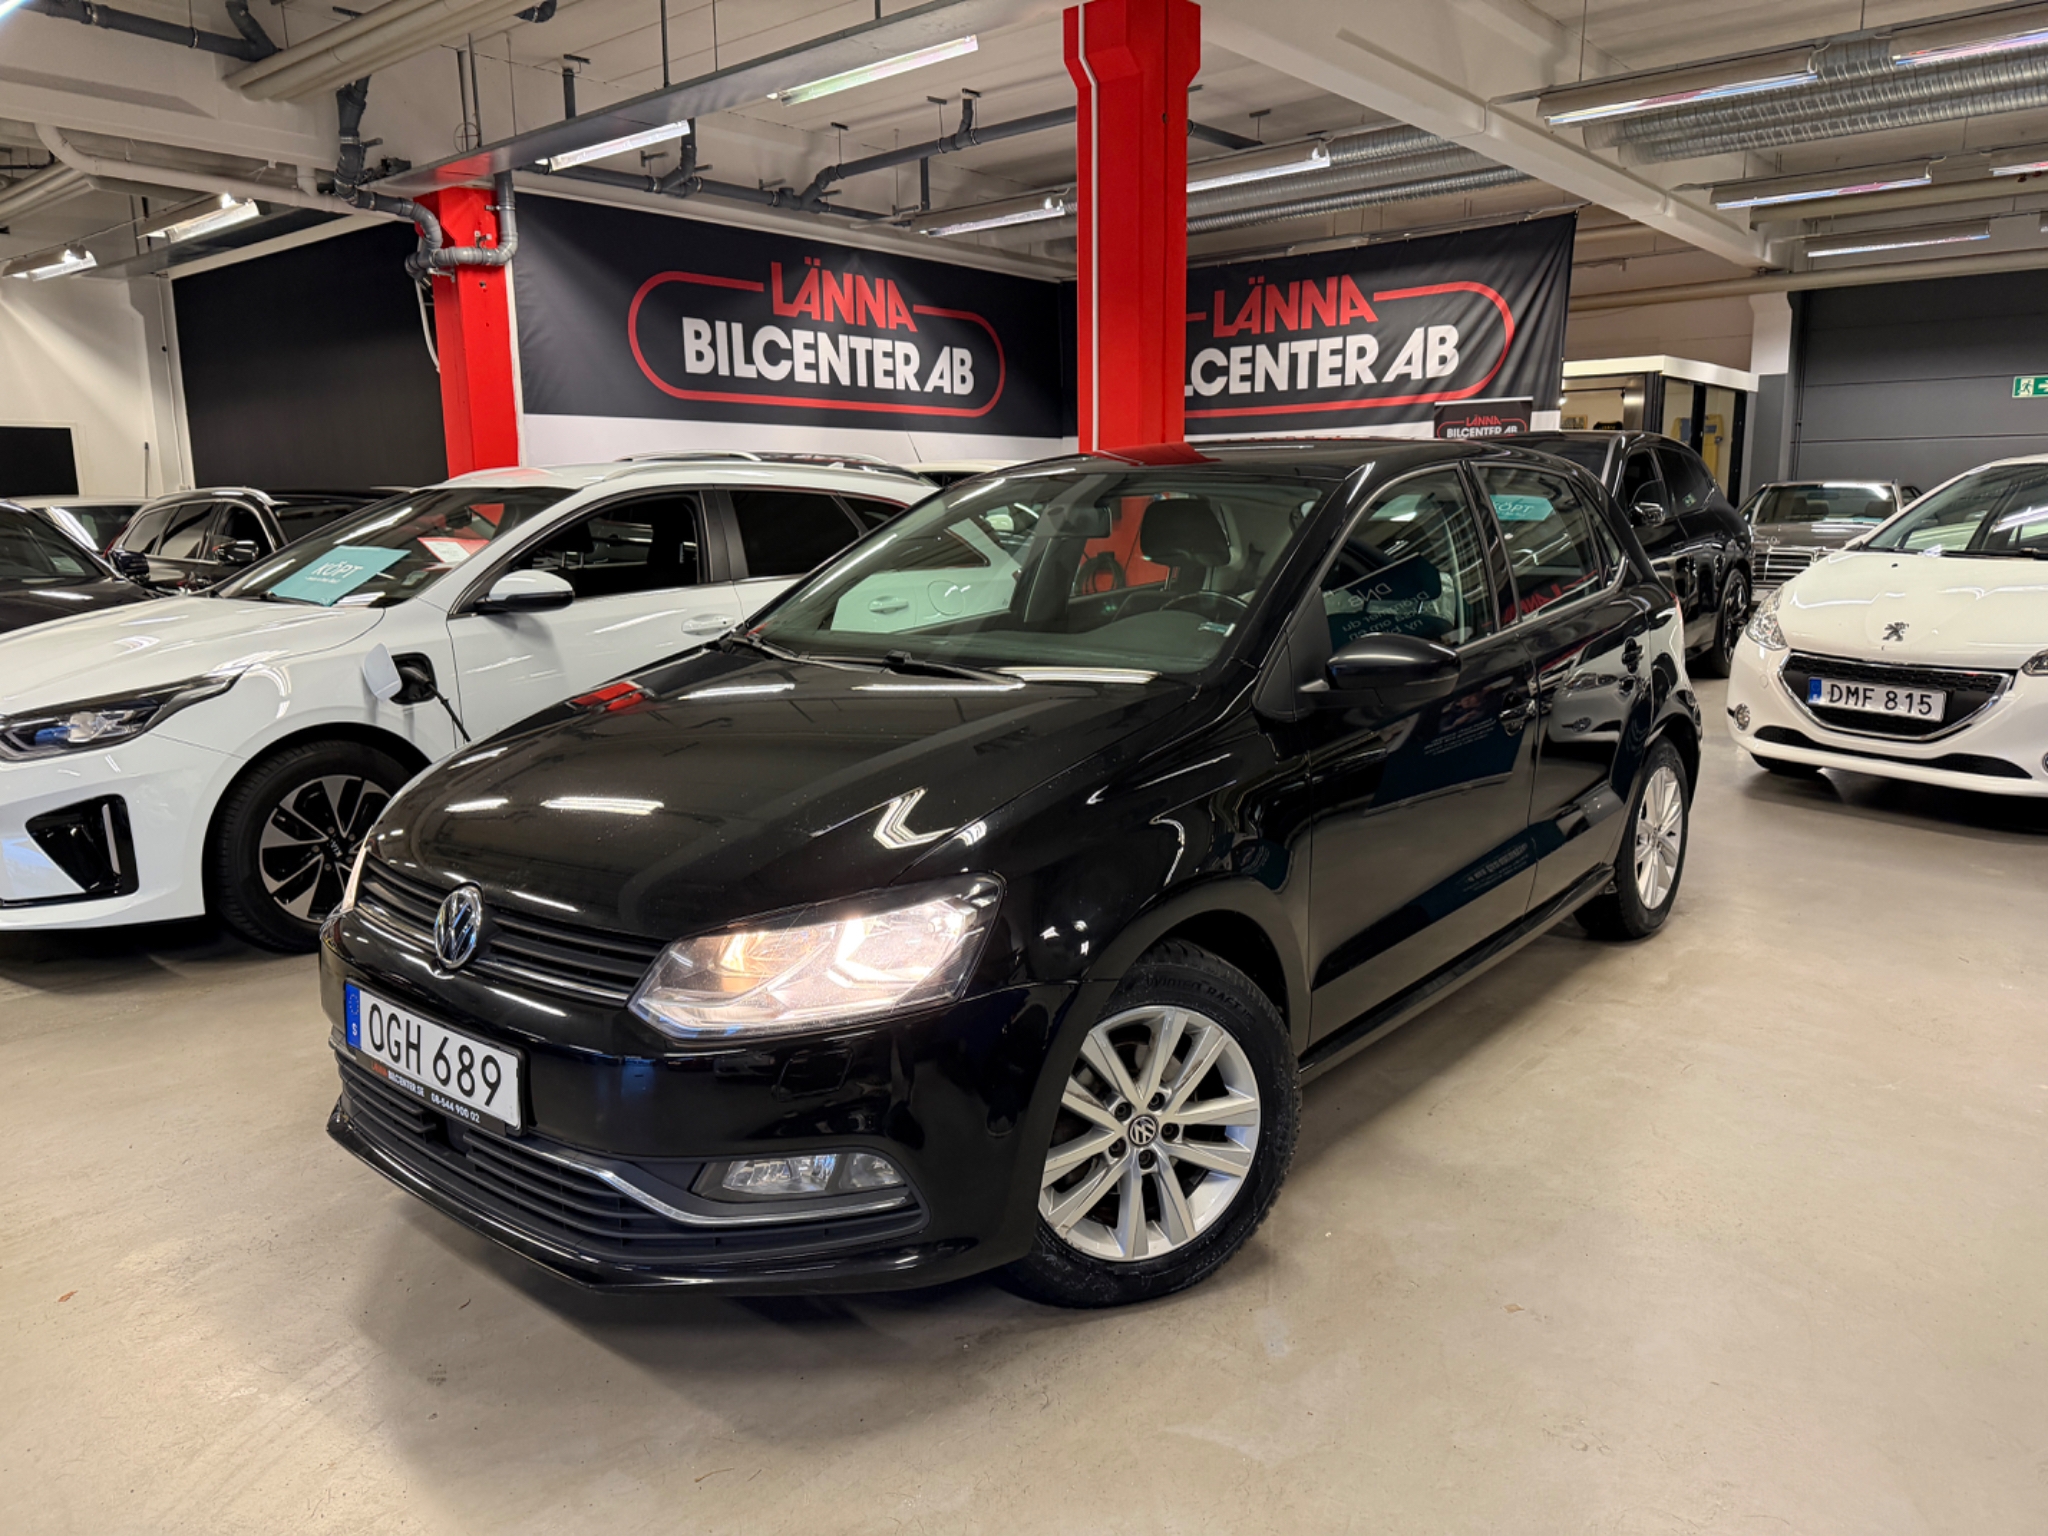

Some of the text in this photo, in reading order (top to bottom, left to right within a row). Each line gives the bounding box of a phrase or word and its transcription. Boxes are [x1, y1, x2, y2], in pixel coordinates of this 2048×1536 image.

[771, 256, 918, 332] LÄNNA
[1213, 273, 1379, 338] LÄNNA
[682, 316, 975, 396] BILCENTER AB
[1381, 324, 1461, 384] AB
[1465, 414, 1502, 427] LÄNNA
[311, 560, 364, 579] KÖPT
[1828, 683, 1933, 716] DMF 815
[369, 1002, 502, 1108] OGH 689
